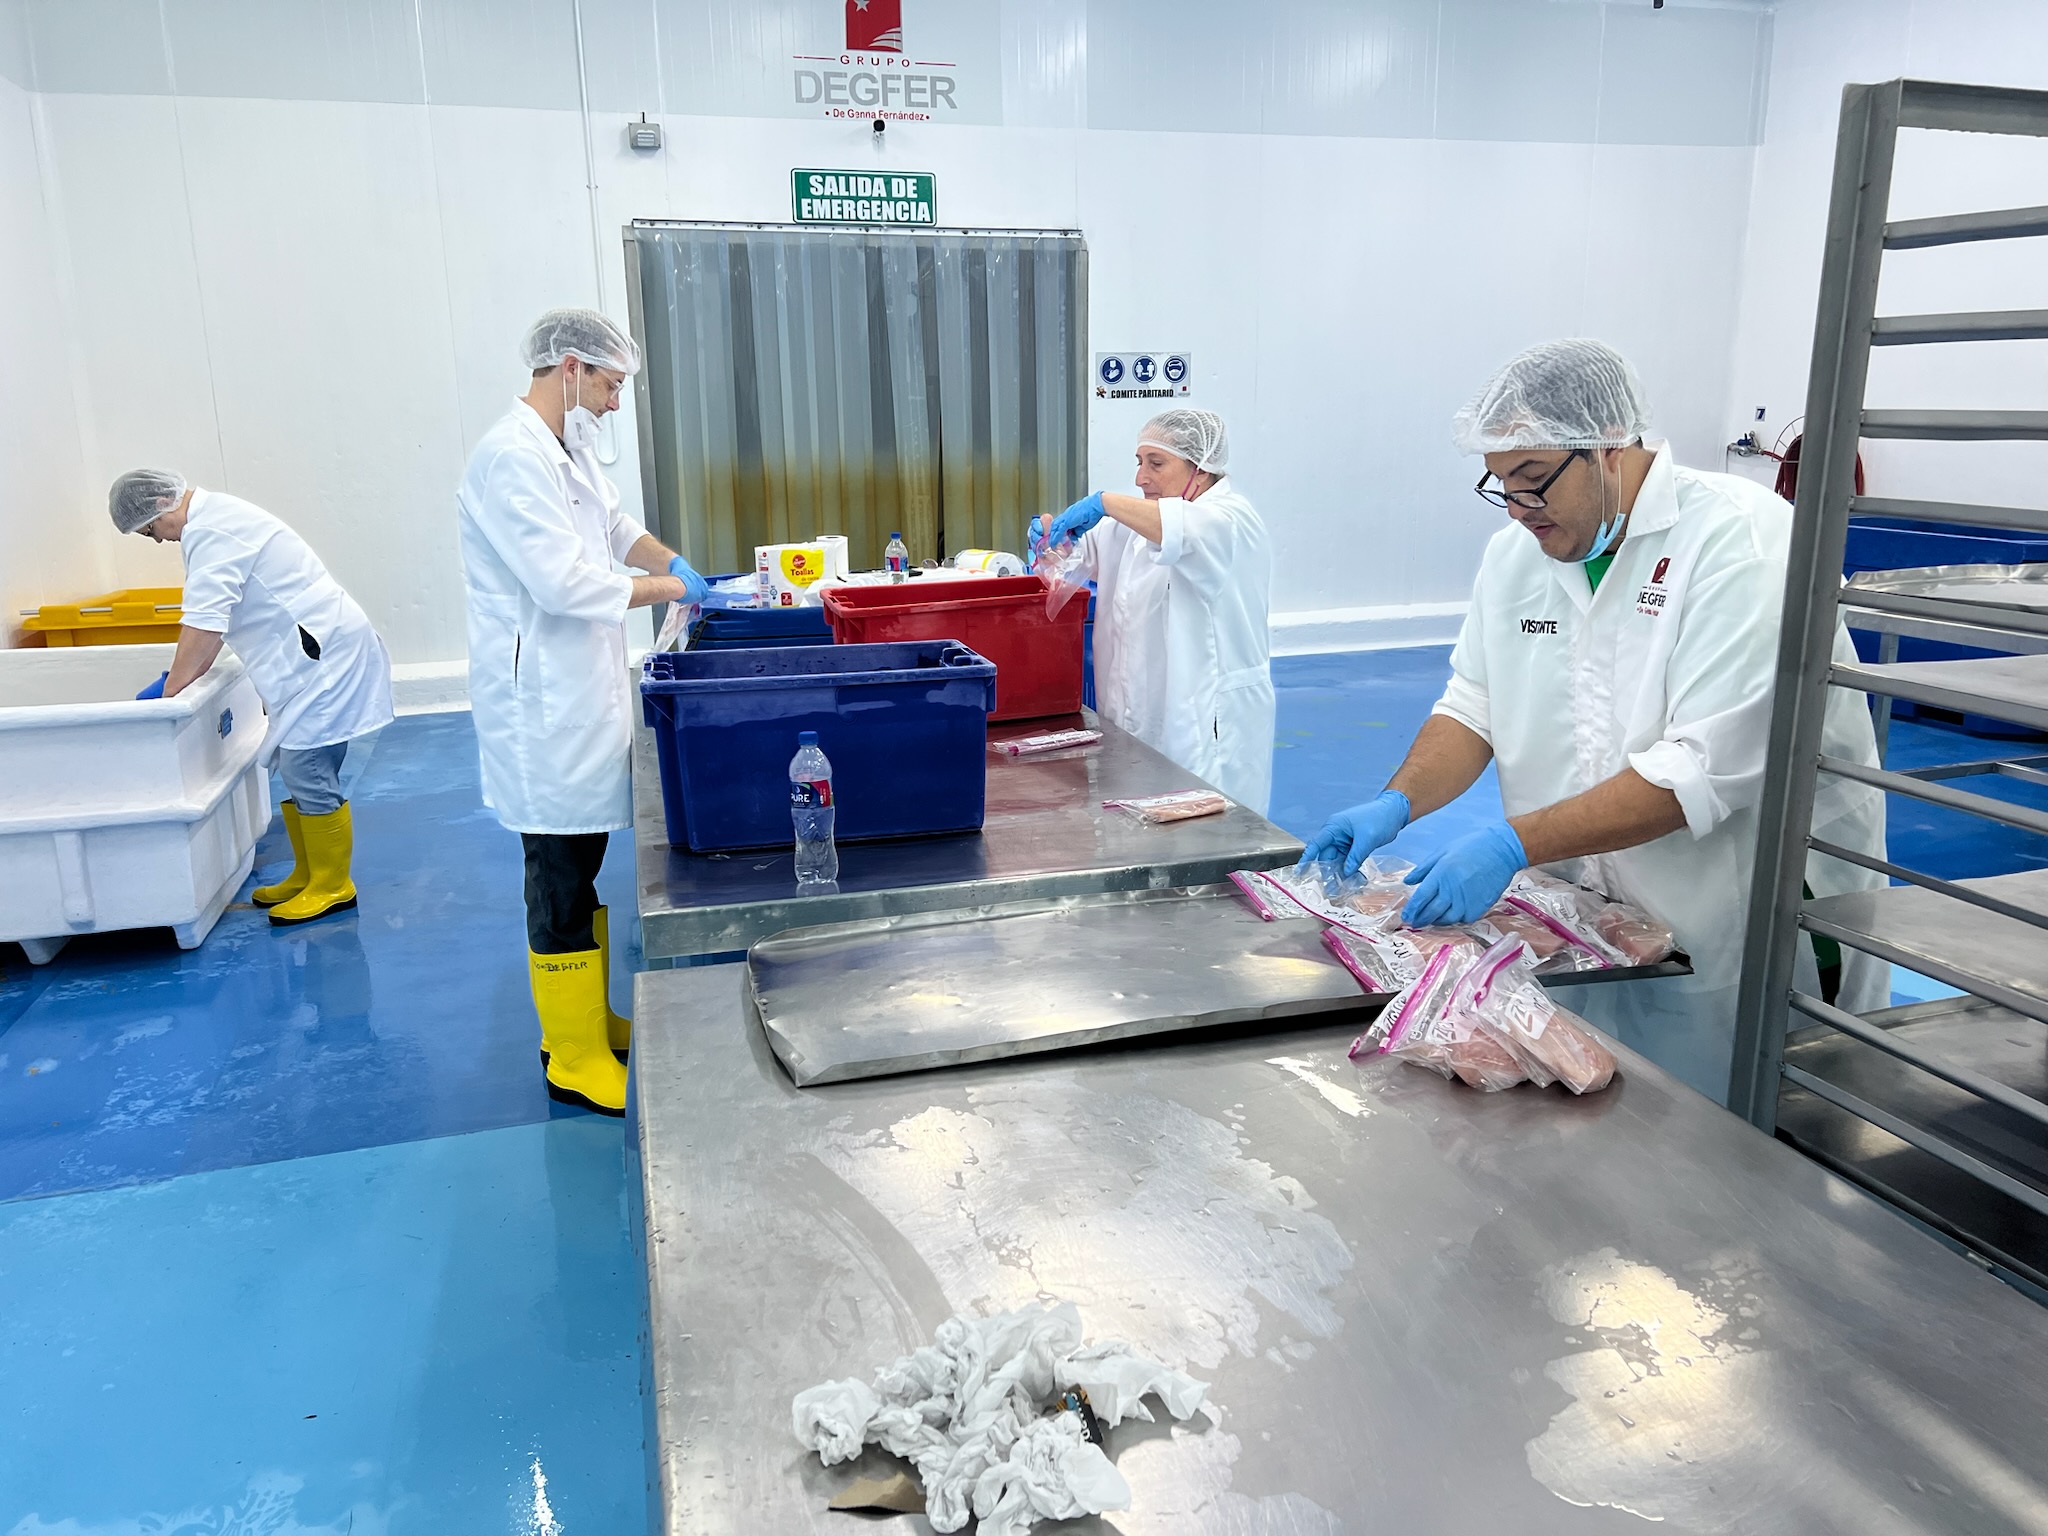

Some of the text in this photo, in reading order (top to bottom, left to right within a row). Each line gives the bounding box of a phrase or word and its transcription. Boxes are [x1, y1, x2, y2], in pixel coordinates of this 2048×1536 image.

[840, 55, 911, 67] GRUPO
[793, 69, 958, 109] DEGFER
[833, 108, 846, 118] De
[878, 109, 925, 121] Fernández
[809, 174, 917, 199] SALIDA DE
[801, 198, 931, 222] EMERGENCIA
[1111, 390, 1137, 399] COMITE
[1138, 389, 1174, 398] PARITARIO
[1757, 408, 1766, 420] 7
[790, 568, 815, 576] Toallas
